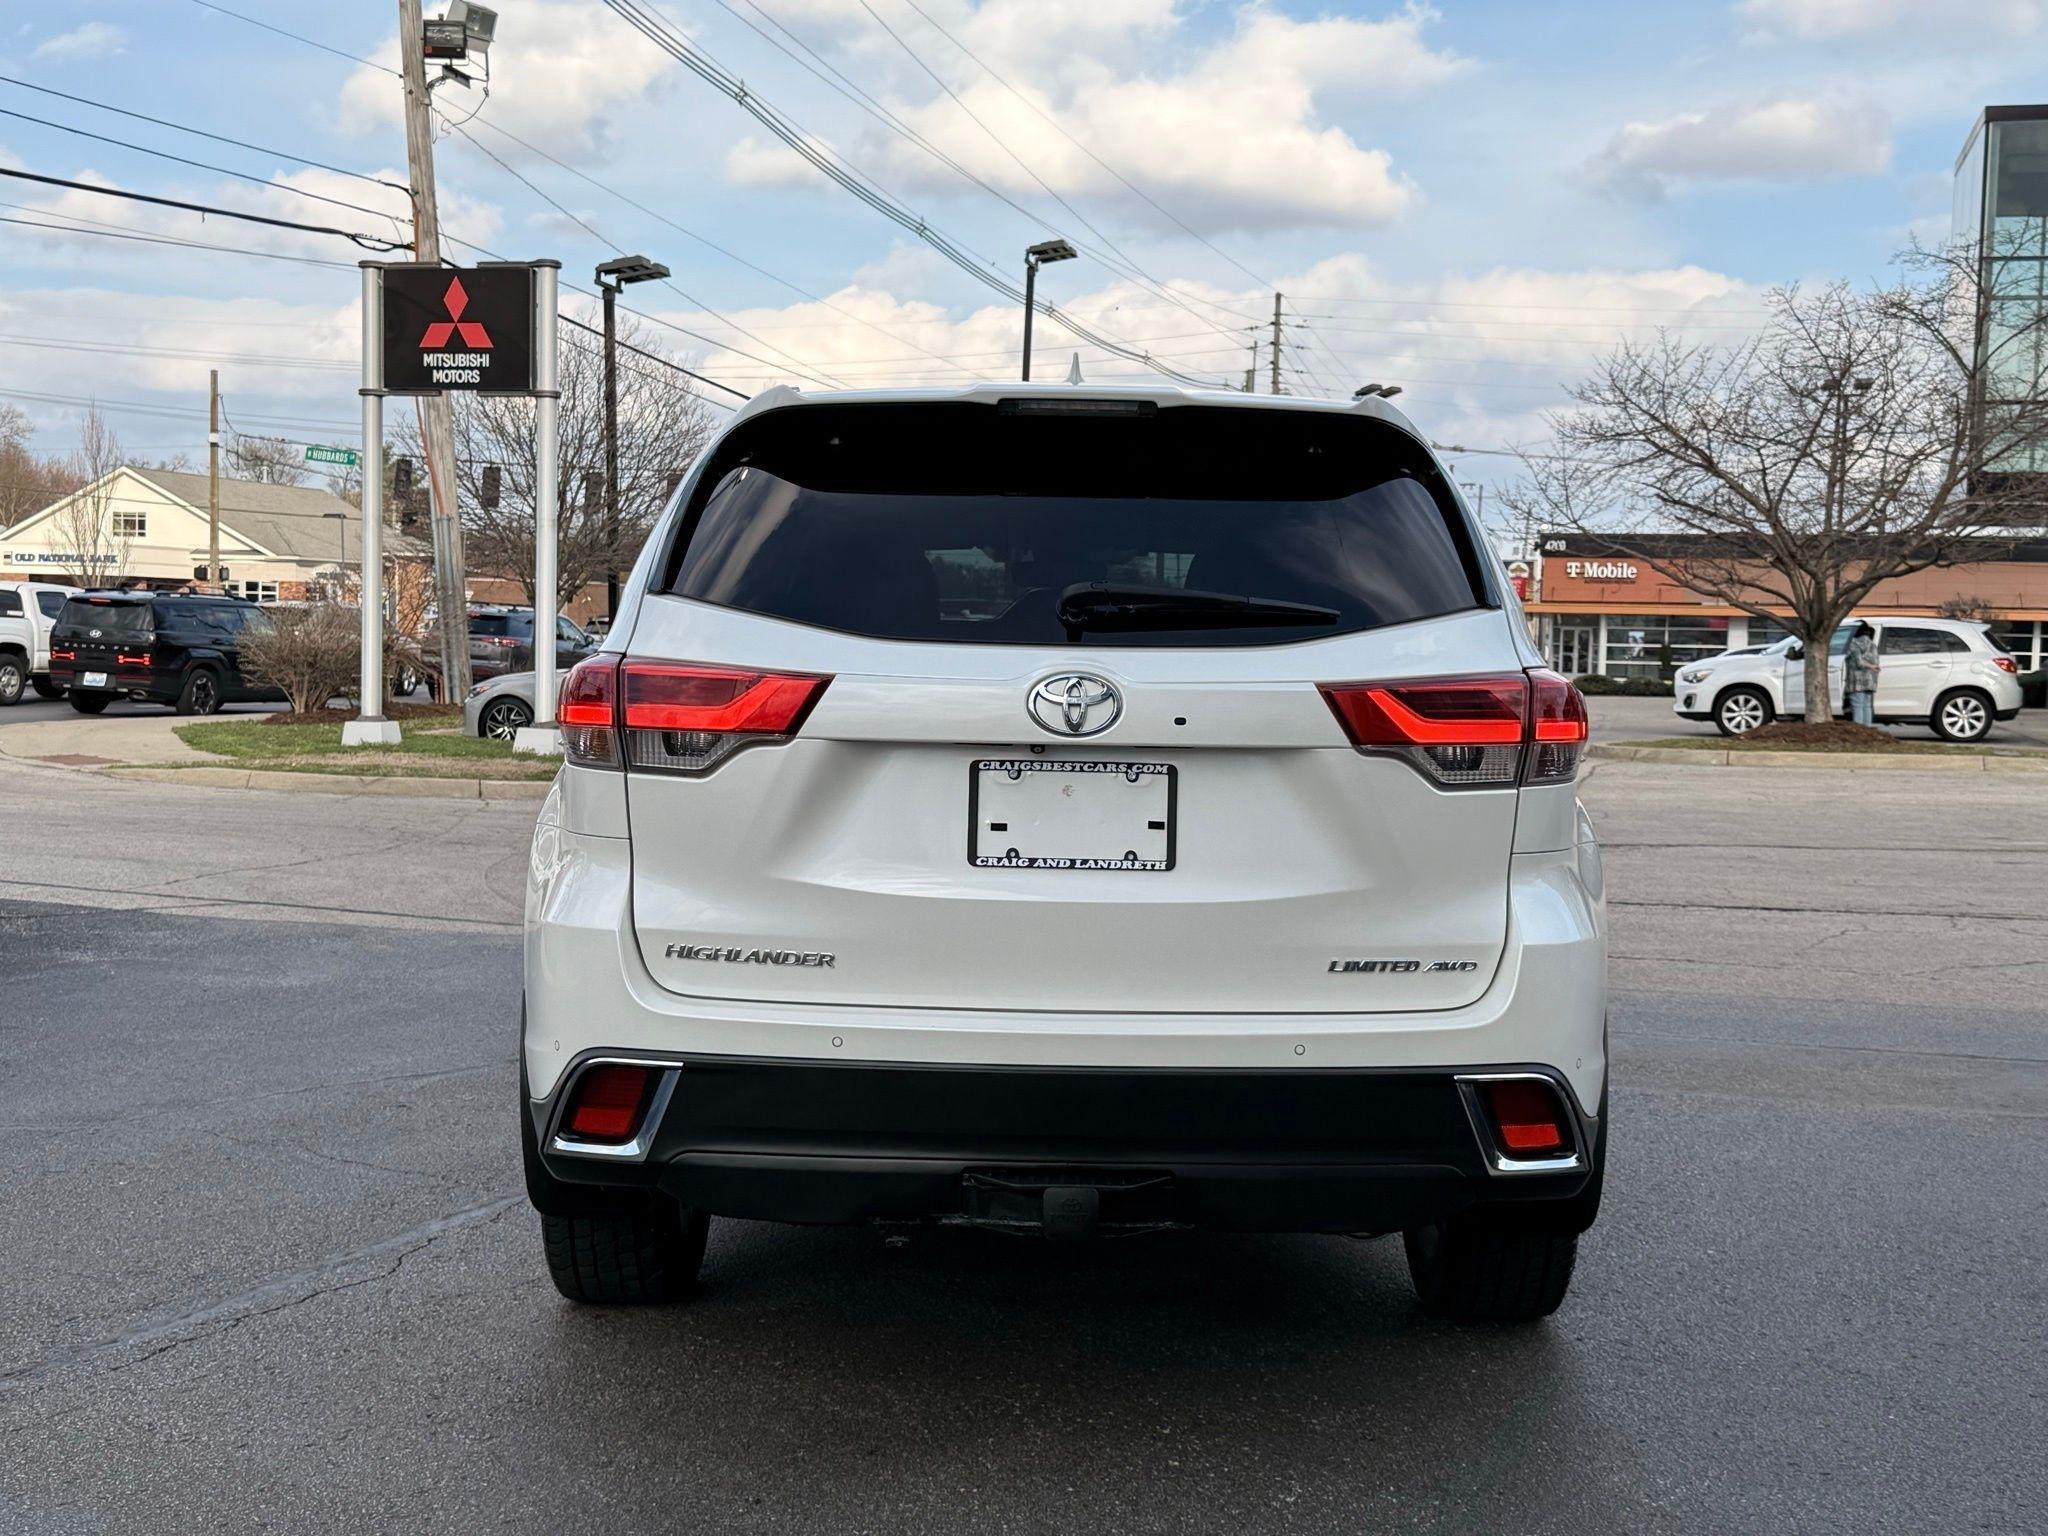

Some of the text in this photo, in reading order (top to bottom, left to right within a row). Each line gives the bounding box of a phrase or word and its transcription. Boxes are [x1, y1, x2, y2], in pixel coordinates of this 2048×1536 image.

[423, 353, 490, 368] MITSUBISHI
[432, 370, 481, 384] MOTORS
[312, 449, 349, 463] HUBBARDS
[14, 553, 35, 562] OLD
[978, 760, 1170, 775] CRAIGSBESTCARS.COM
[976, 856, 1168, 871] CRAIG AND LANDRETH
[664, 942, 837, 969] HIGHLANDER
[1328, 958, 1479, 973] LIMITED AWD
